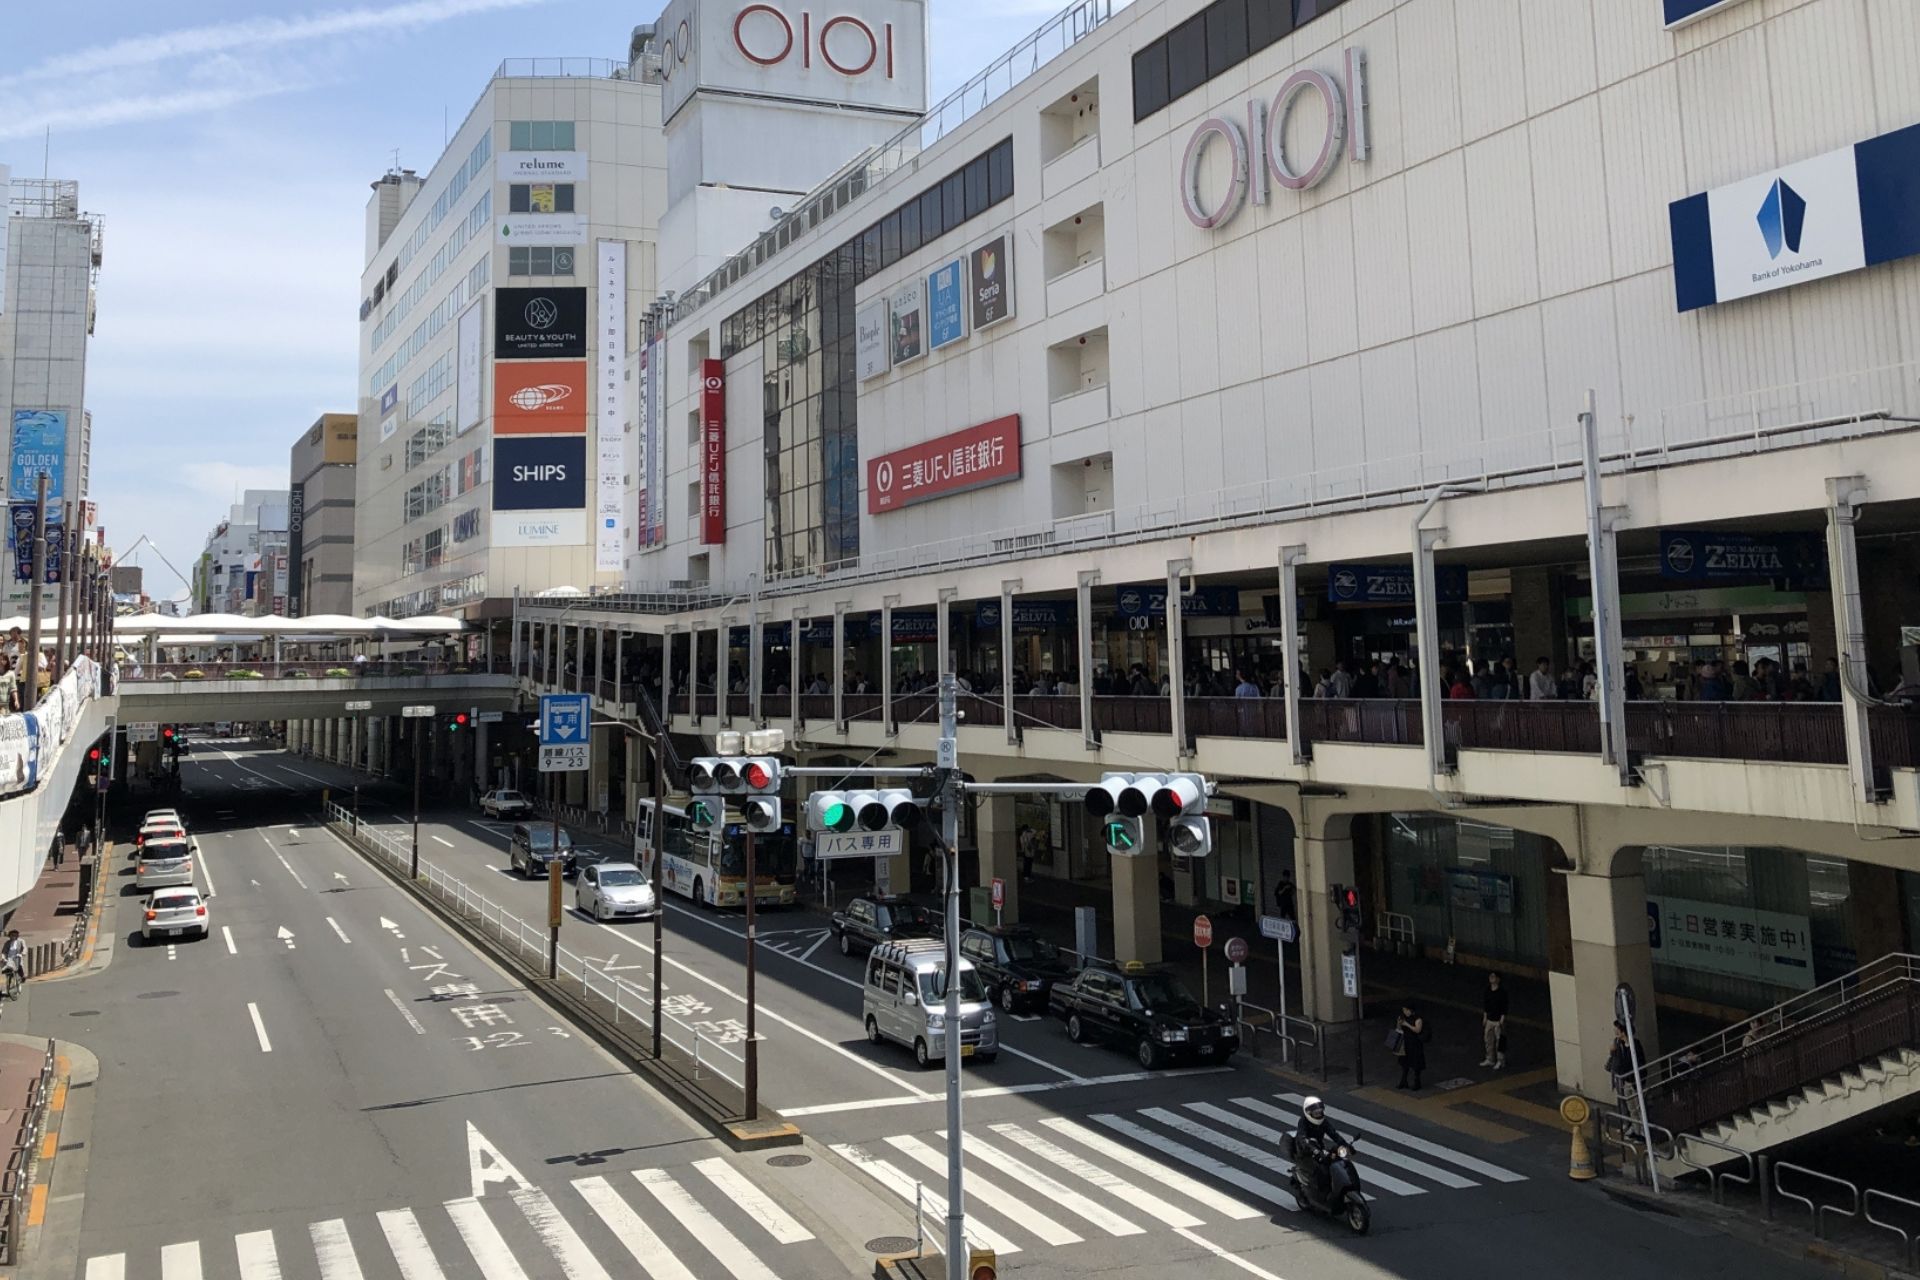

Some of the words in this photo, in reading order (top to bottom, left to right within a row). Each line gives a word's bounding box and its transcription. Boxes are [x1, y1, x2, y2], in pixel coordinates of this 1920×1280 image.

[520, 157, 565, 169] relume
[1751, 271, 1771, 282] Bank
[1771, 268, 1780, 277] of
[1781, 258, 1823, 274] Yokohama
[979, 281, 1000, 302] Seria
[985, 307, 994, 321] 6F
[17, 454, 59, 466] GOLDEN
[709, 420, 720, 518] 三菱UFJ信託銀行
[902, 436, 1004, 491] 三菱UFJ信託銀行
[512, 464, 567, 482] SHIPS
[518, 524, 560, 535] LUMINE
[1705, 545, 1784, 568] ZELVIA
[1366, 575, 1415, 595] ZELV
[1149, 593, 1209, 611] ZVIA
[554, 714, 577, 724] 専用
[543, 747, 585, 758] 路線バス
[827, 835, 892, 852] バス専用
[1668, 912, 1806, 951] 土日営業実施中!
